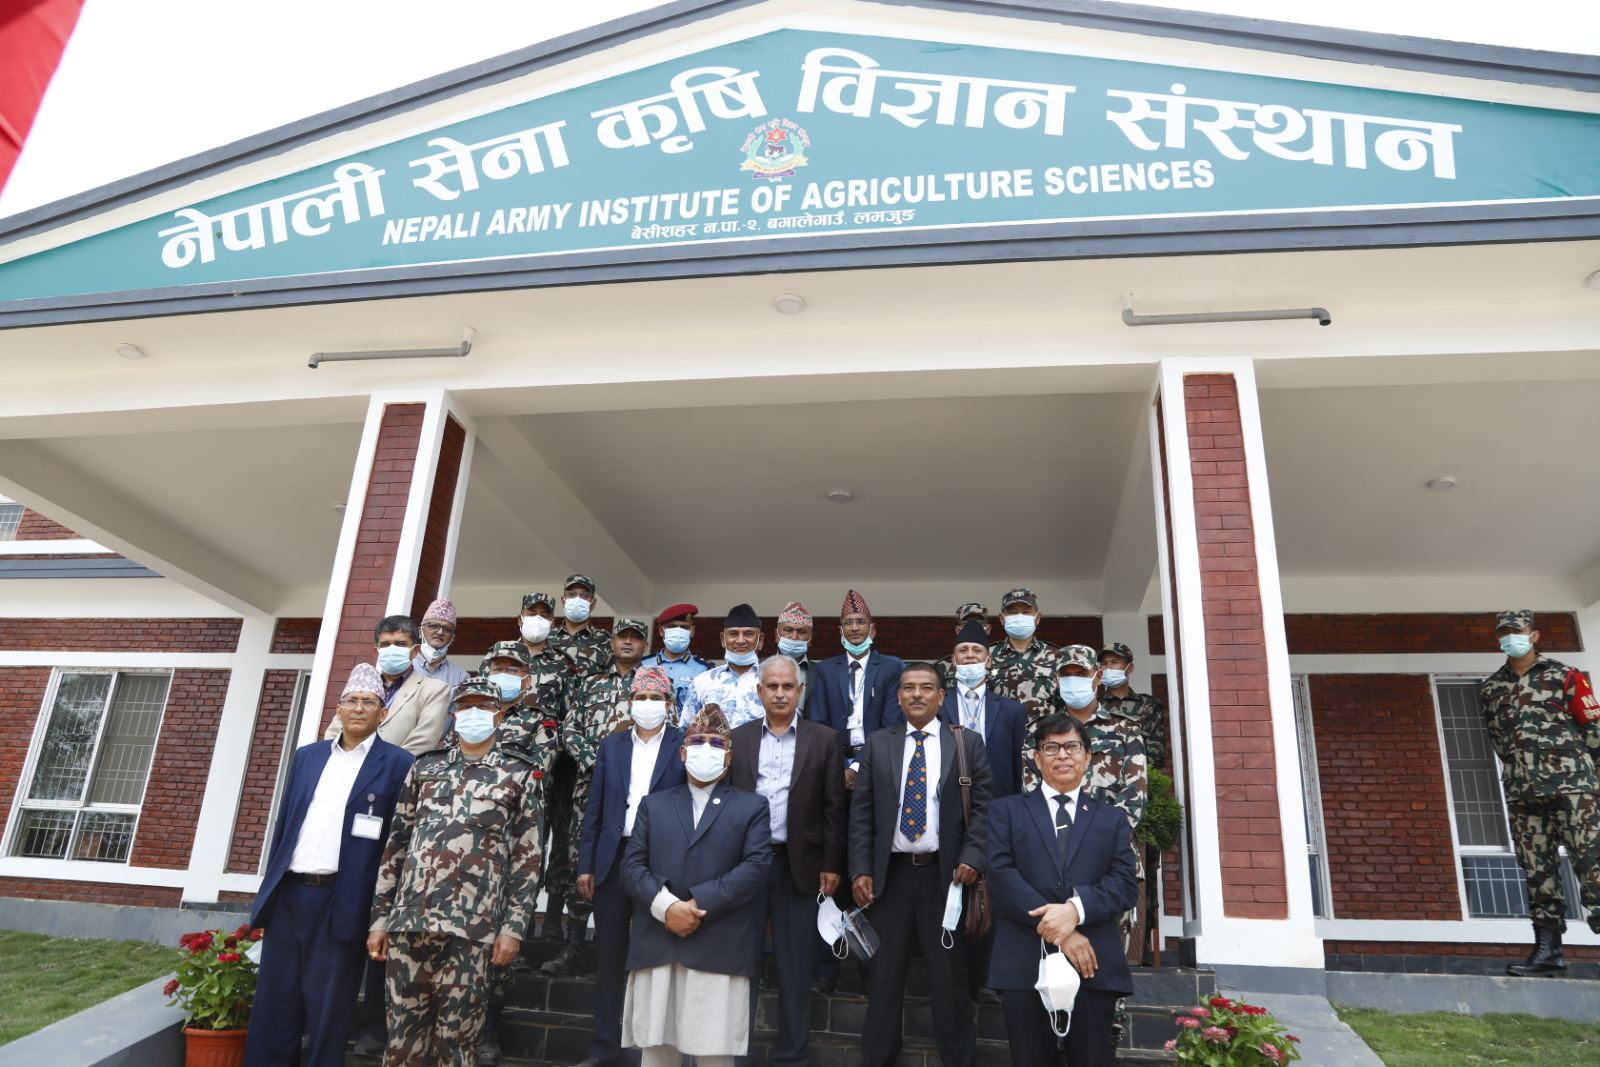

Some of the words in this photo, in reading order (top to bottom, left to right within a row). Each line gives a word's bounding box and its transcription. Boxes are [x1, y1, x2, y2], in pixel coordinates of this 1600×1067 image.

[158, 162, 386, 268] नेपाली
[408, 119, 570, 201] सेना
[590, 66, 768, 154] कृषि
[796, 47, 1077, 136] विज्ञान
[1106, 83, 1463, 180] संस्थान
[382, 212, 481, 245] NEPALI
[485, 202, 573, 236] ARMY
[578, 188, 740, 227] INSTITUTE
[751, 184, 792, 213] OF
[800, 168, 1034, 210] AGRICULTURE
[1044, 160, 1215, 196] SCIENCES
[630, 223, 699, 240] बेसीशहर
[853, 209, 916, 225] लमजुङ
